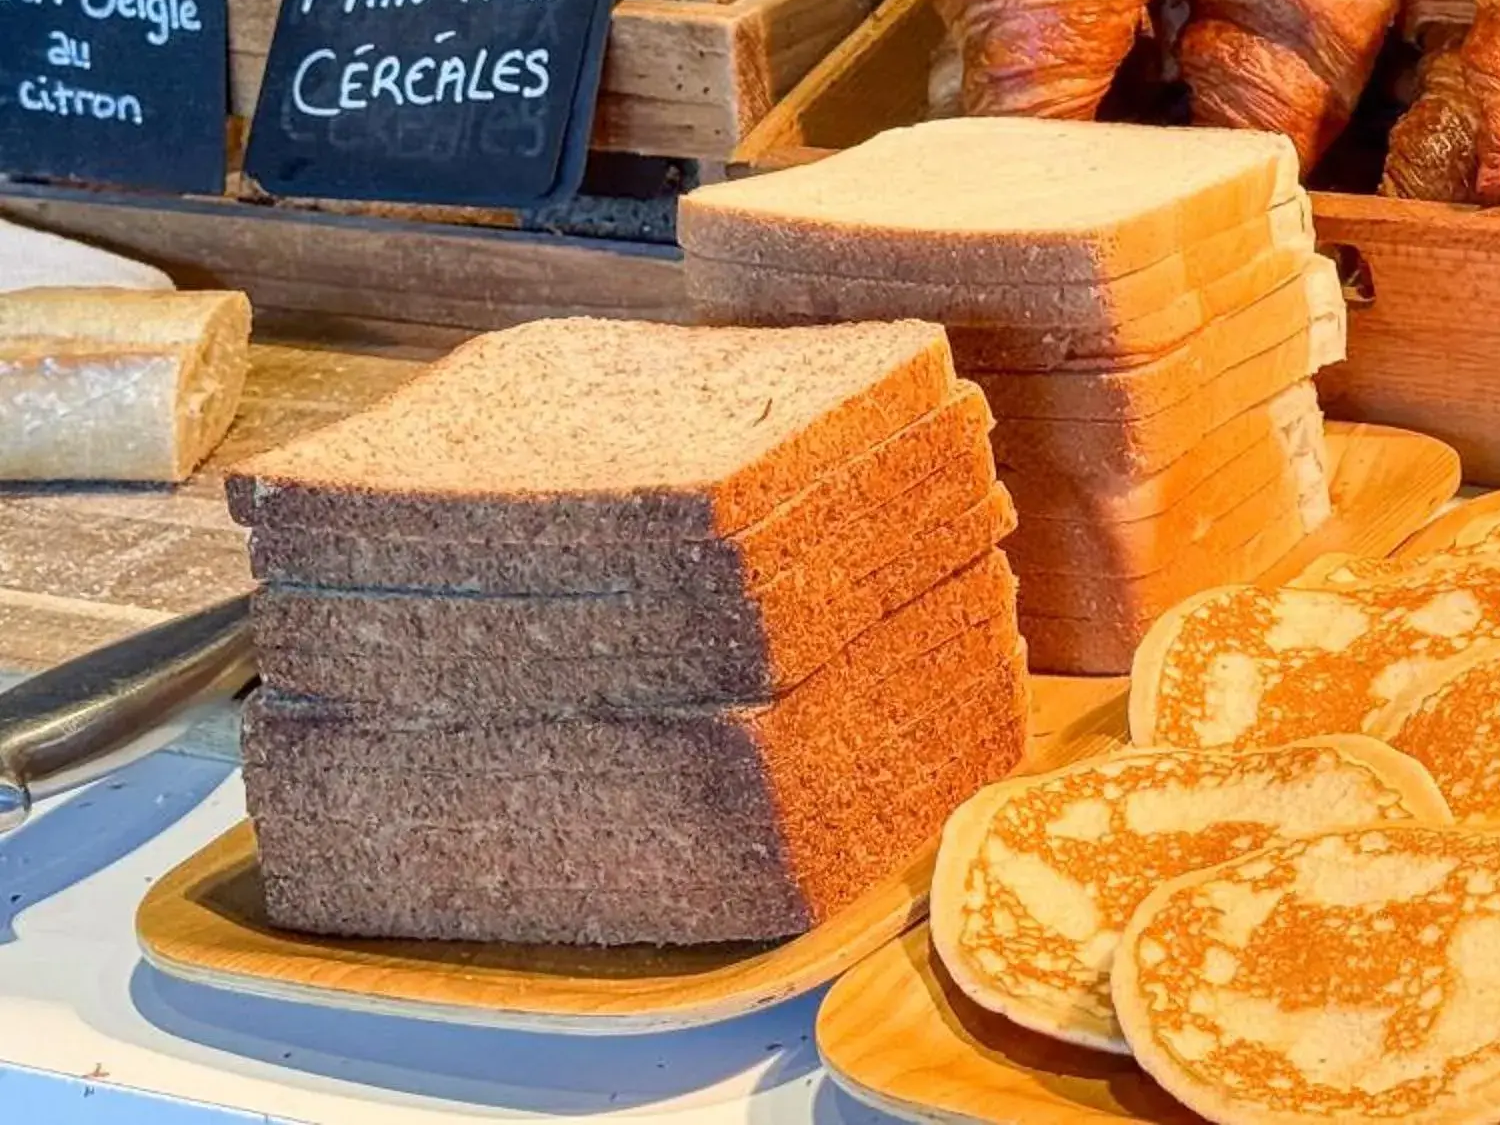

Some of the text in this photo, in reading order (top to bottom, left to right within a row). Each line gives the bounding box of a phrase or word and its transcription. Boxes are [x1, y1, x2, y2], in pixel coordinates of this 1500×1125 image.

[48, 30, 91, 70] au
[292, 30, 549, 116] CÉRÉALES
[19, 75, 143, 124] citron
